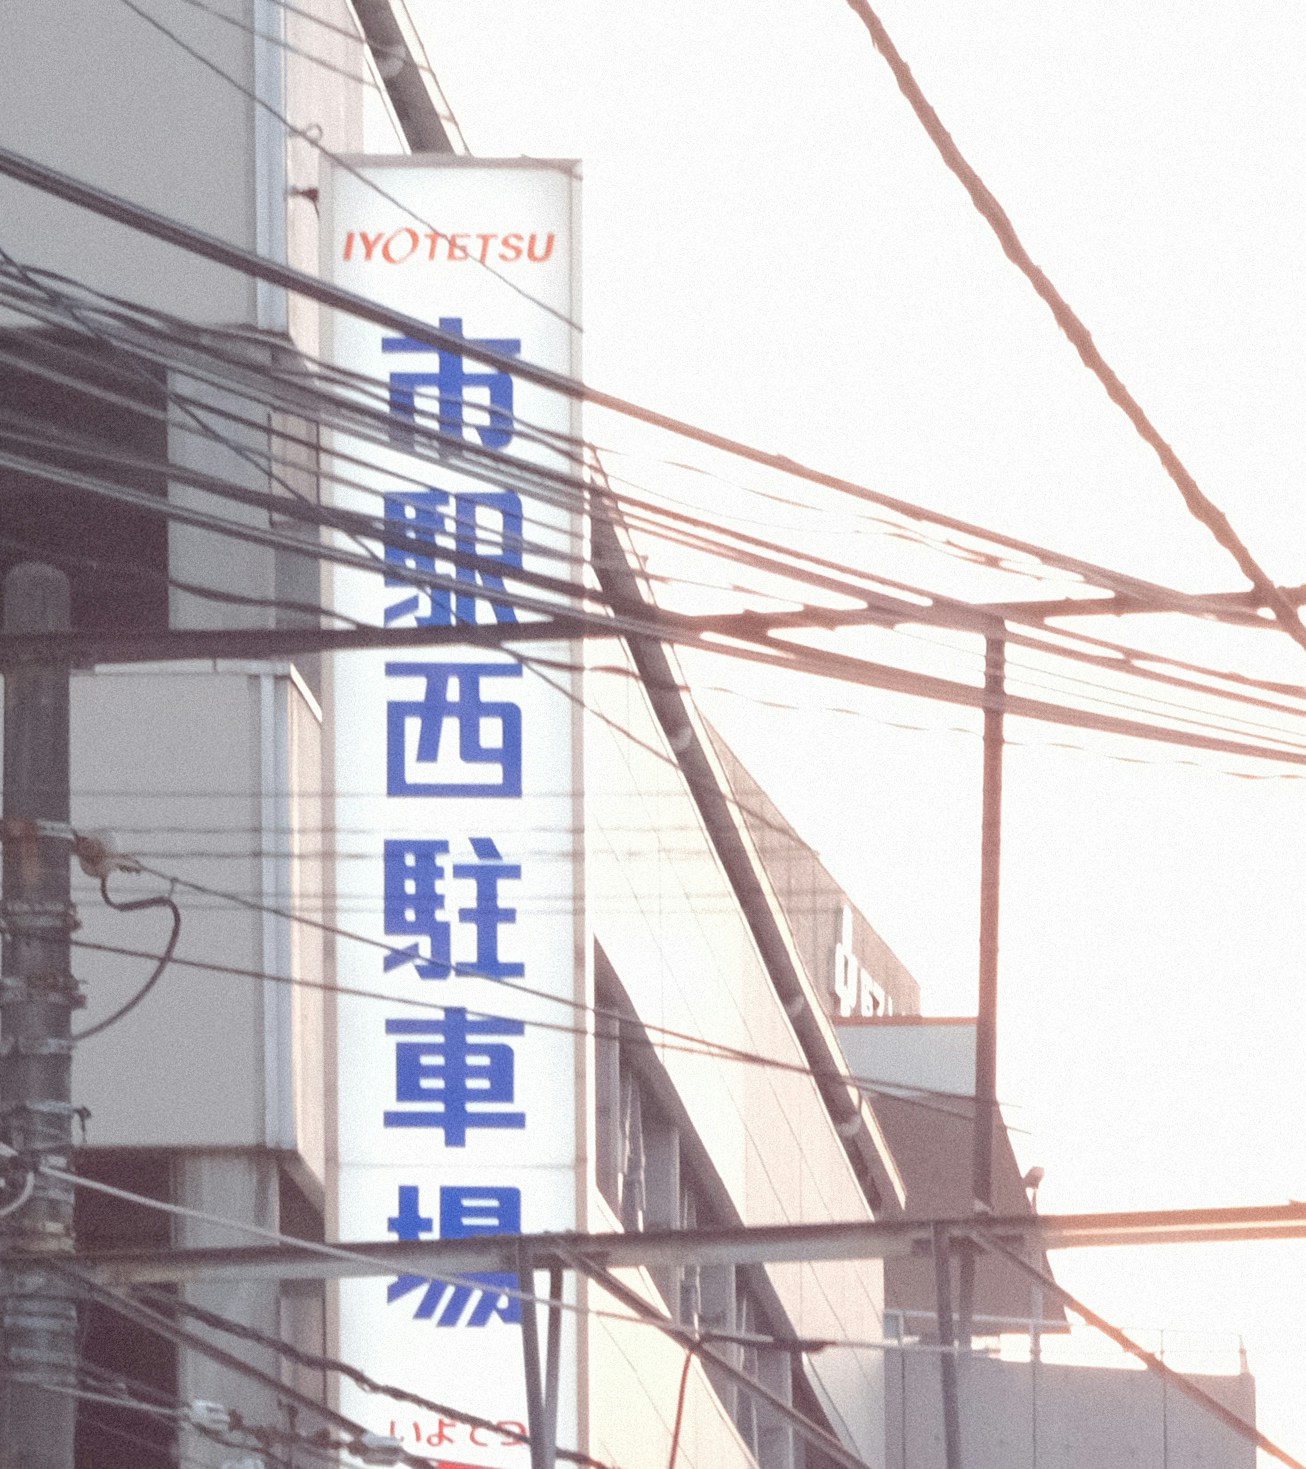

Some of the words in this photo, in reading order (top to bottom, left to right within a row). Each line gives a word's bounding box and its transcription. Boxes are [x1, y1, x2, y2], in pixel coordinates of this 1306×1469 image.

[343, 227, 555, 264] IYOTETSU
[381, 316, 527, 1327] 市駅西駐車場
